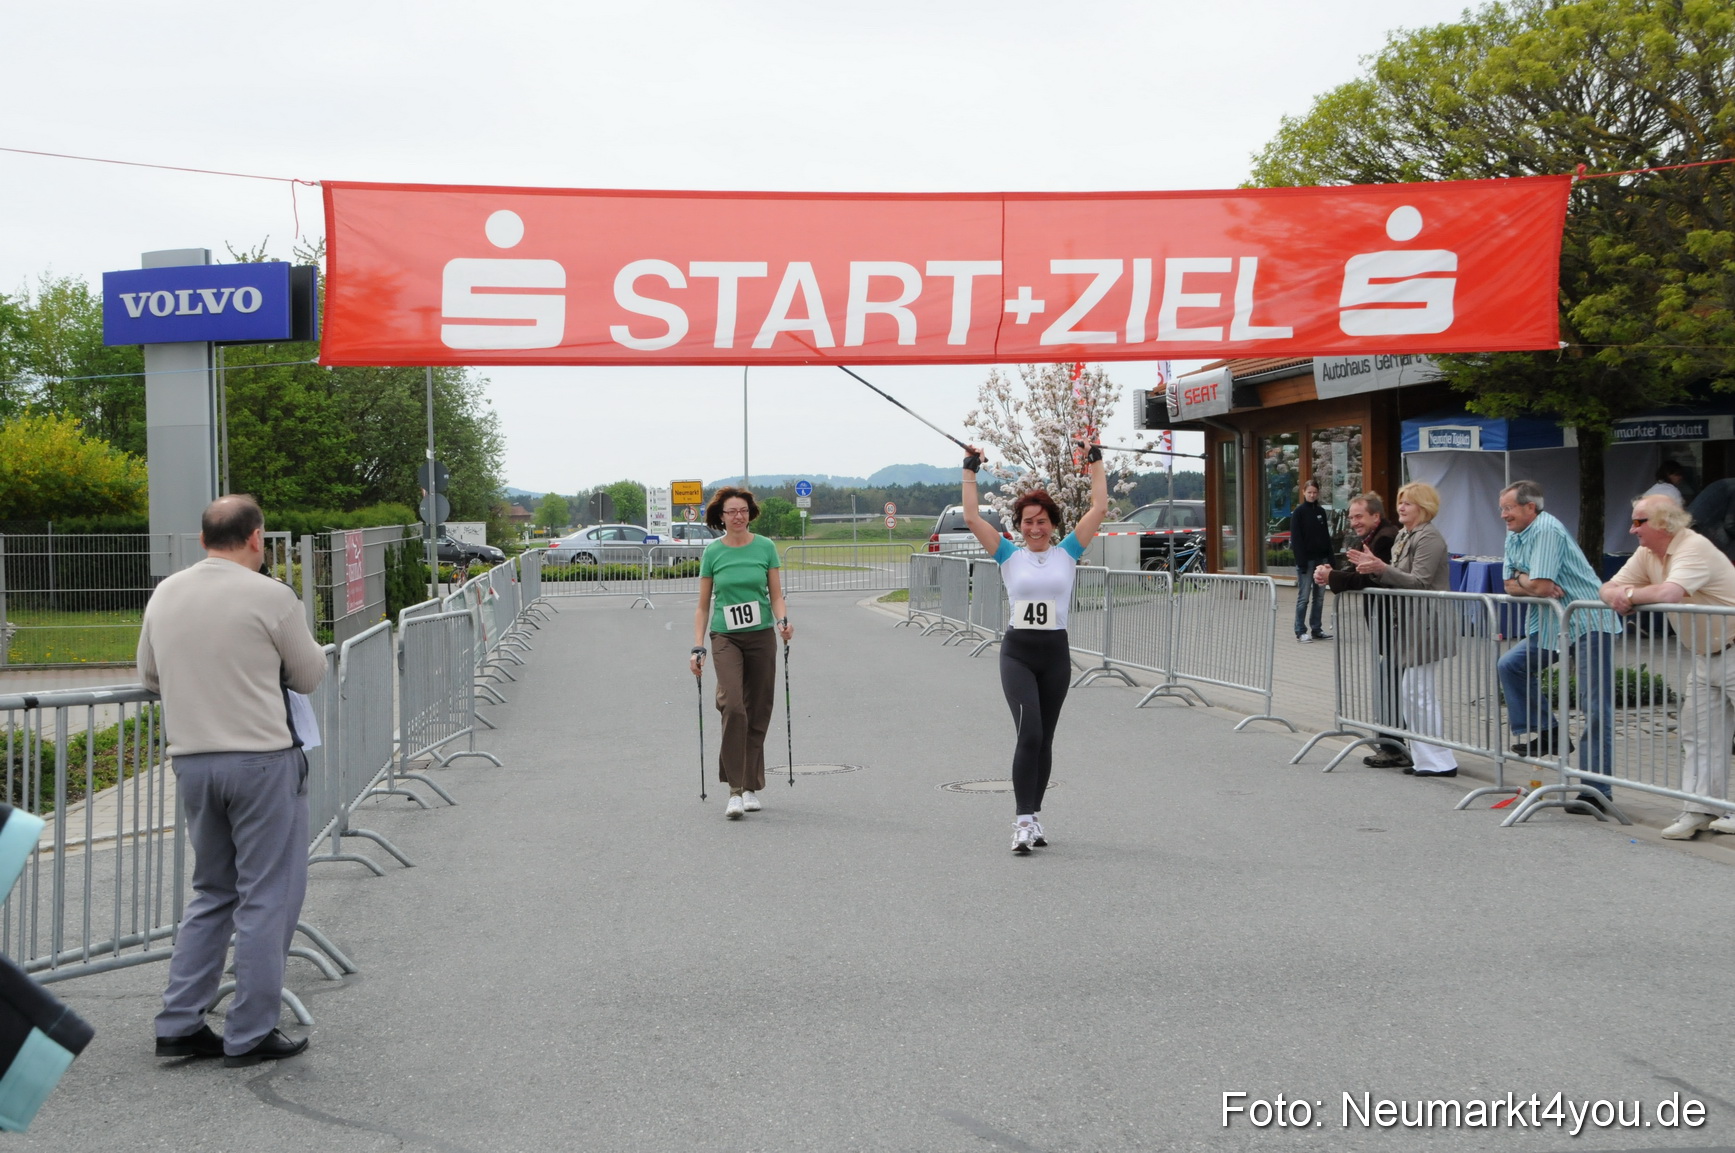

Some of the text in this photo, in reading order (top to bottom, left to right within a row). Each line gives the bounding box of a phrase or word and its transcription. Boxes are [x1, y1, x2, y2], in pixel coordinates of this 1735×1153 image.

[119, 286, 263, 318] VOLVO
[1322, 357, 1371, 382] Autohaus
[1183, 383, 1219, 406] SEAT
[1659, 423, 1703, 438] Tagblatt
[730, 604, 753, 626] 119
[1023, 602, 1048, 625] 49
